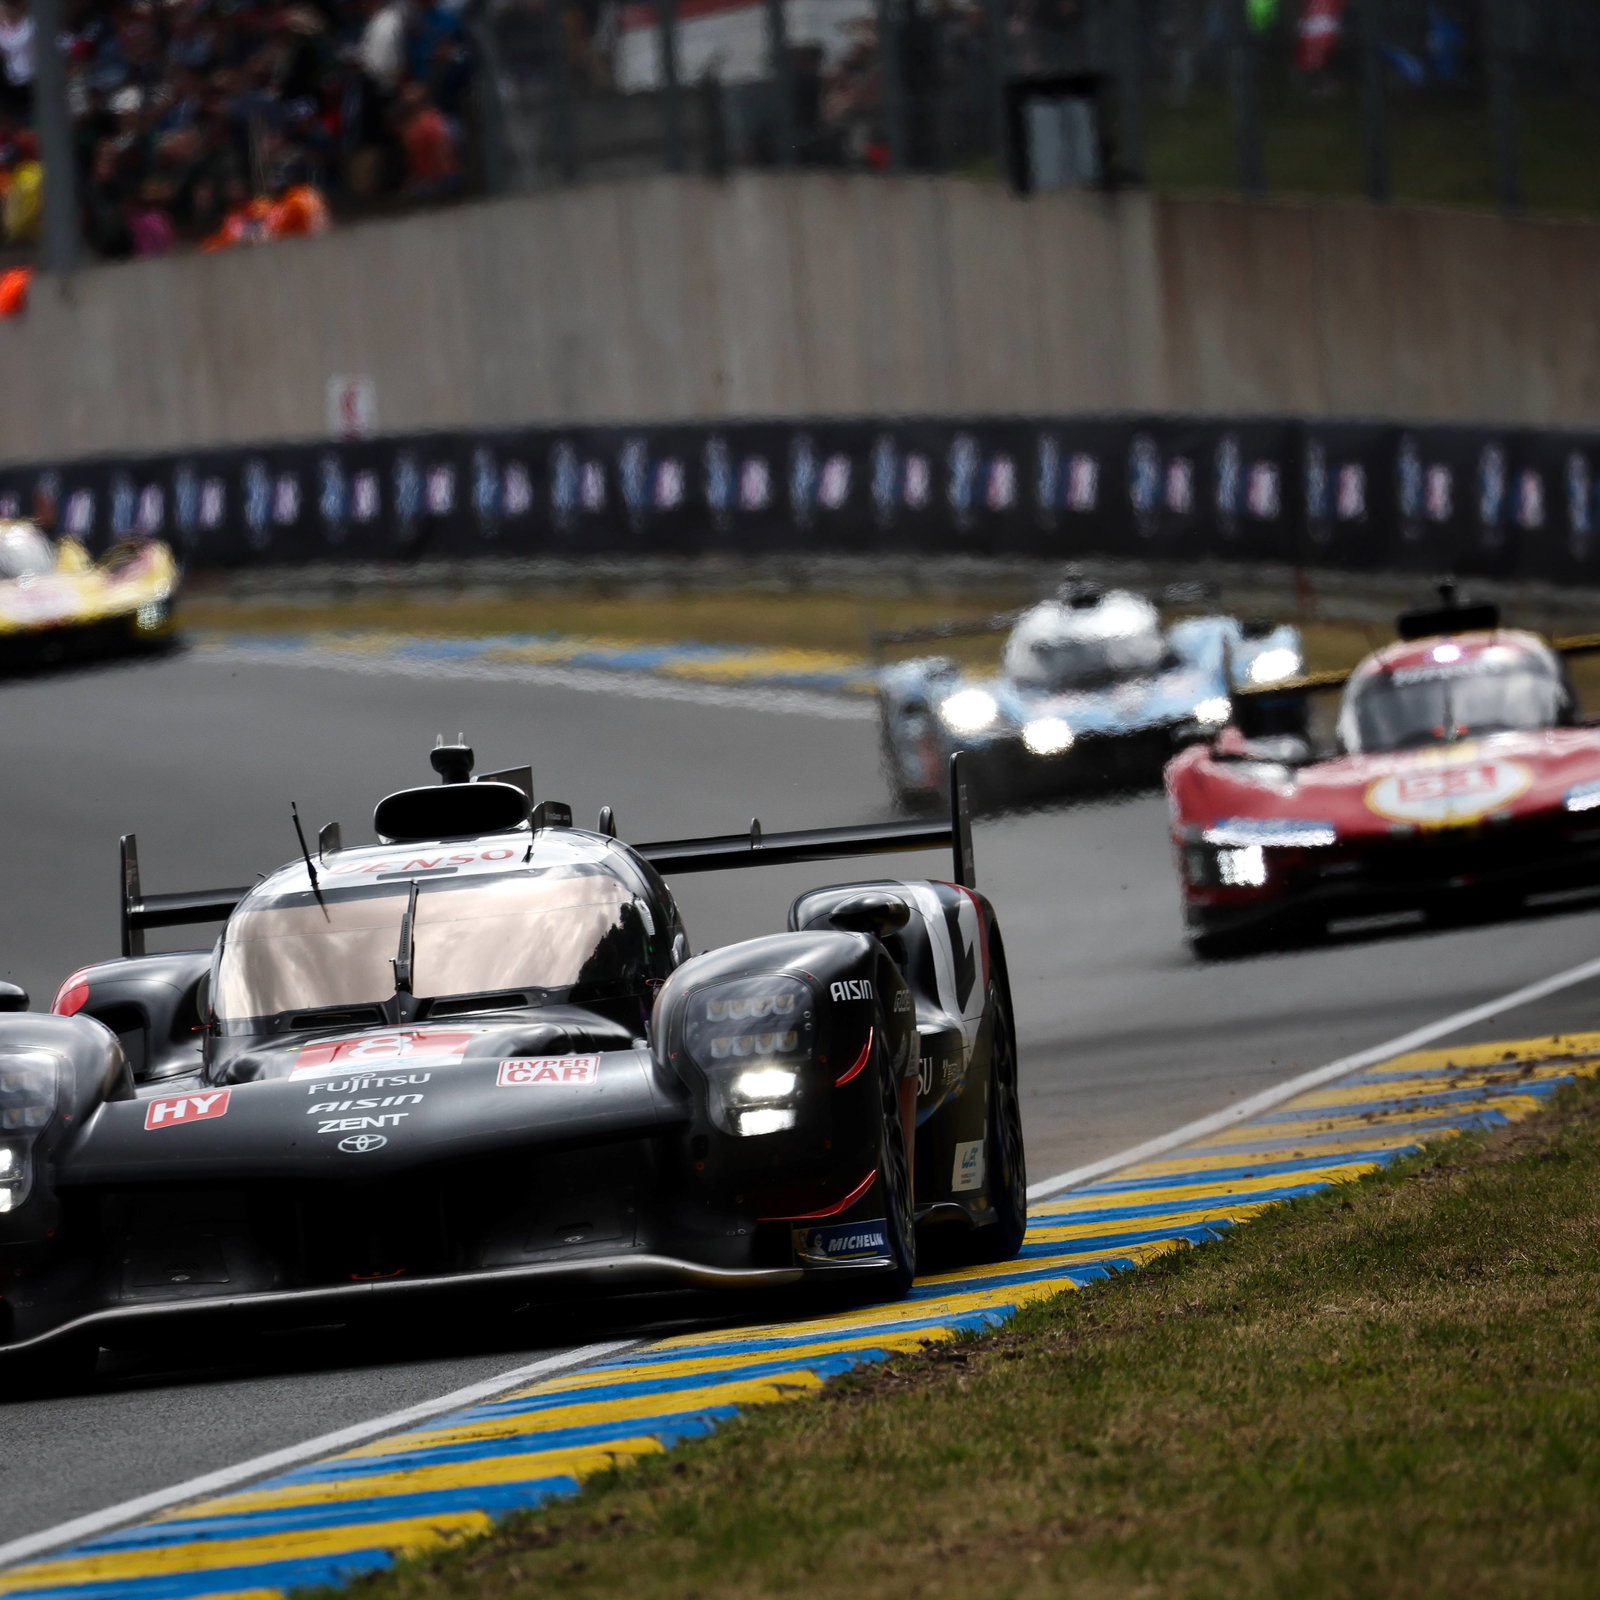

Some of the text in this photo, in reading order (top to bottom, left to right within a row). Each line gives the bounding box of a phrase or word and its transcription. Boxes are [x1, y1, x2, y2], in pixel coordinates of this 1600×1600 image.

[328, 849, 514, 875] DENSO
[830, 980, 873, 1002] AISIN
[349, 1036, 414, 1058] 8
[509, 1057, 589, 1071] HYPER
[308, 1072, 431, 1095] FUJITSU
[507, 1066, 587, 1084] CAR
[152, 1093, 222, 1123] HY
[307, 1094, 424, 1115] AISIN
[317, 1113, 408, 1134] ZENT
[828, 1233, 884, 1252] MICHELIN
